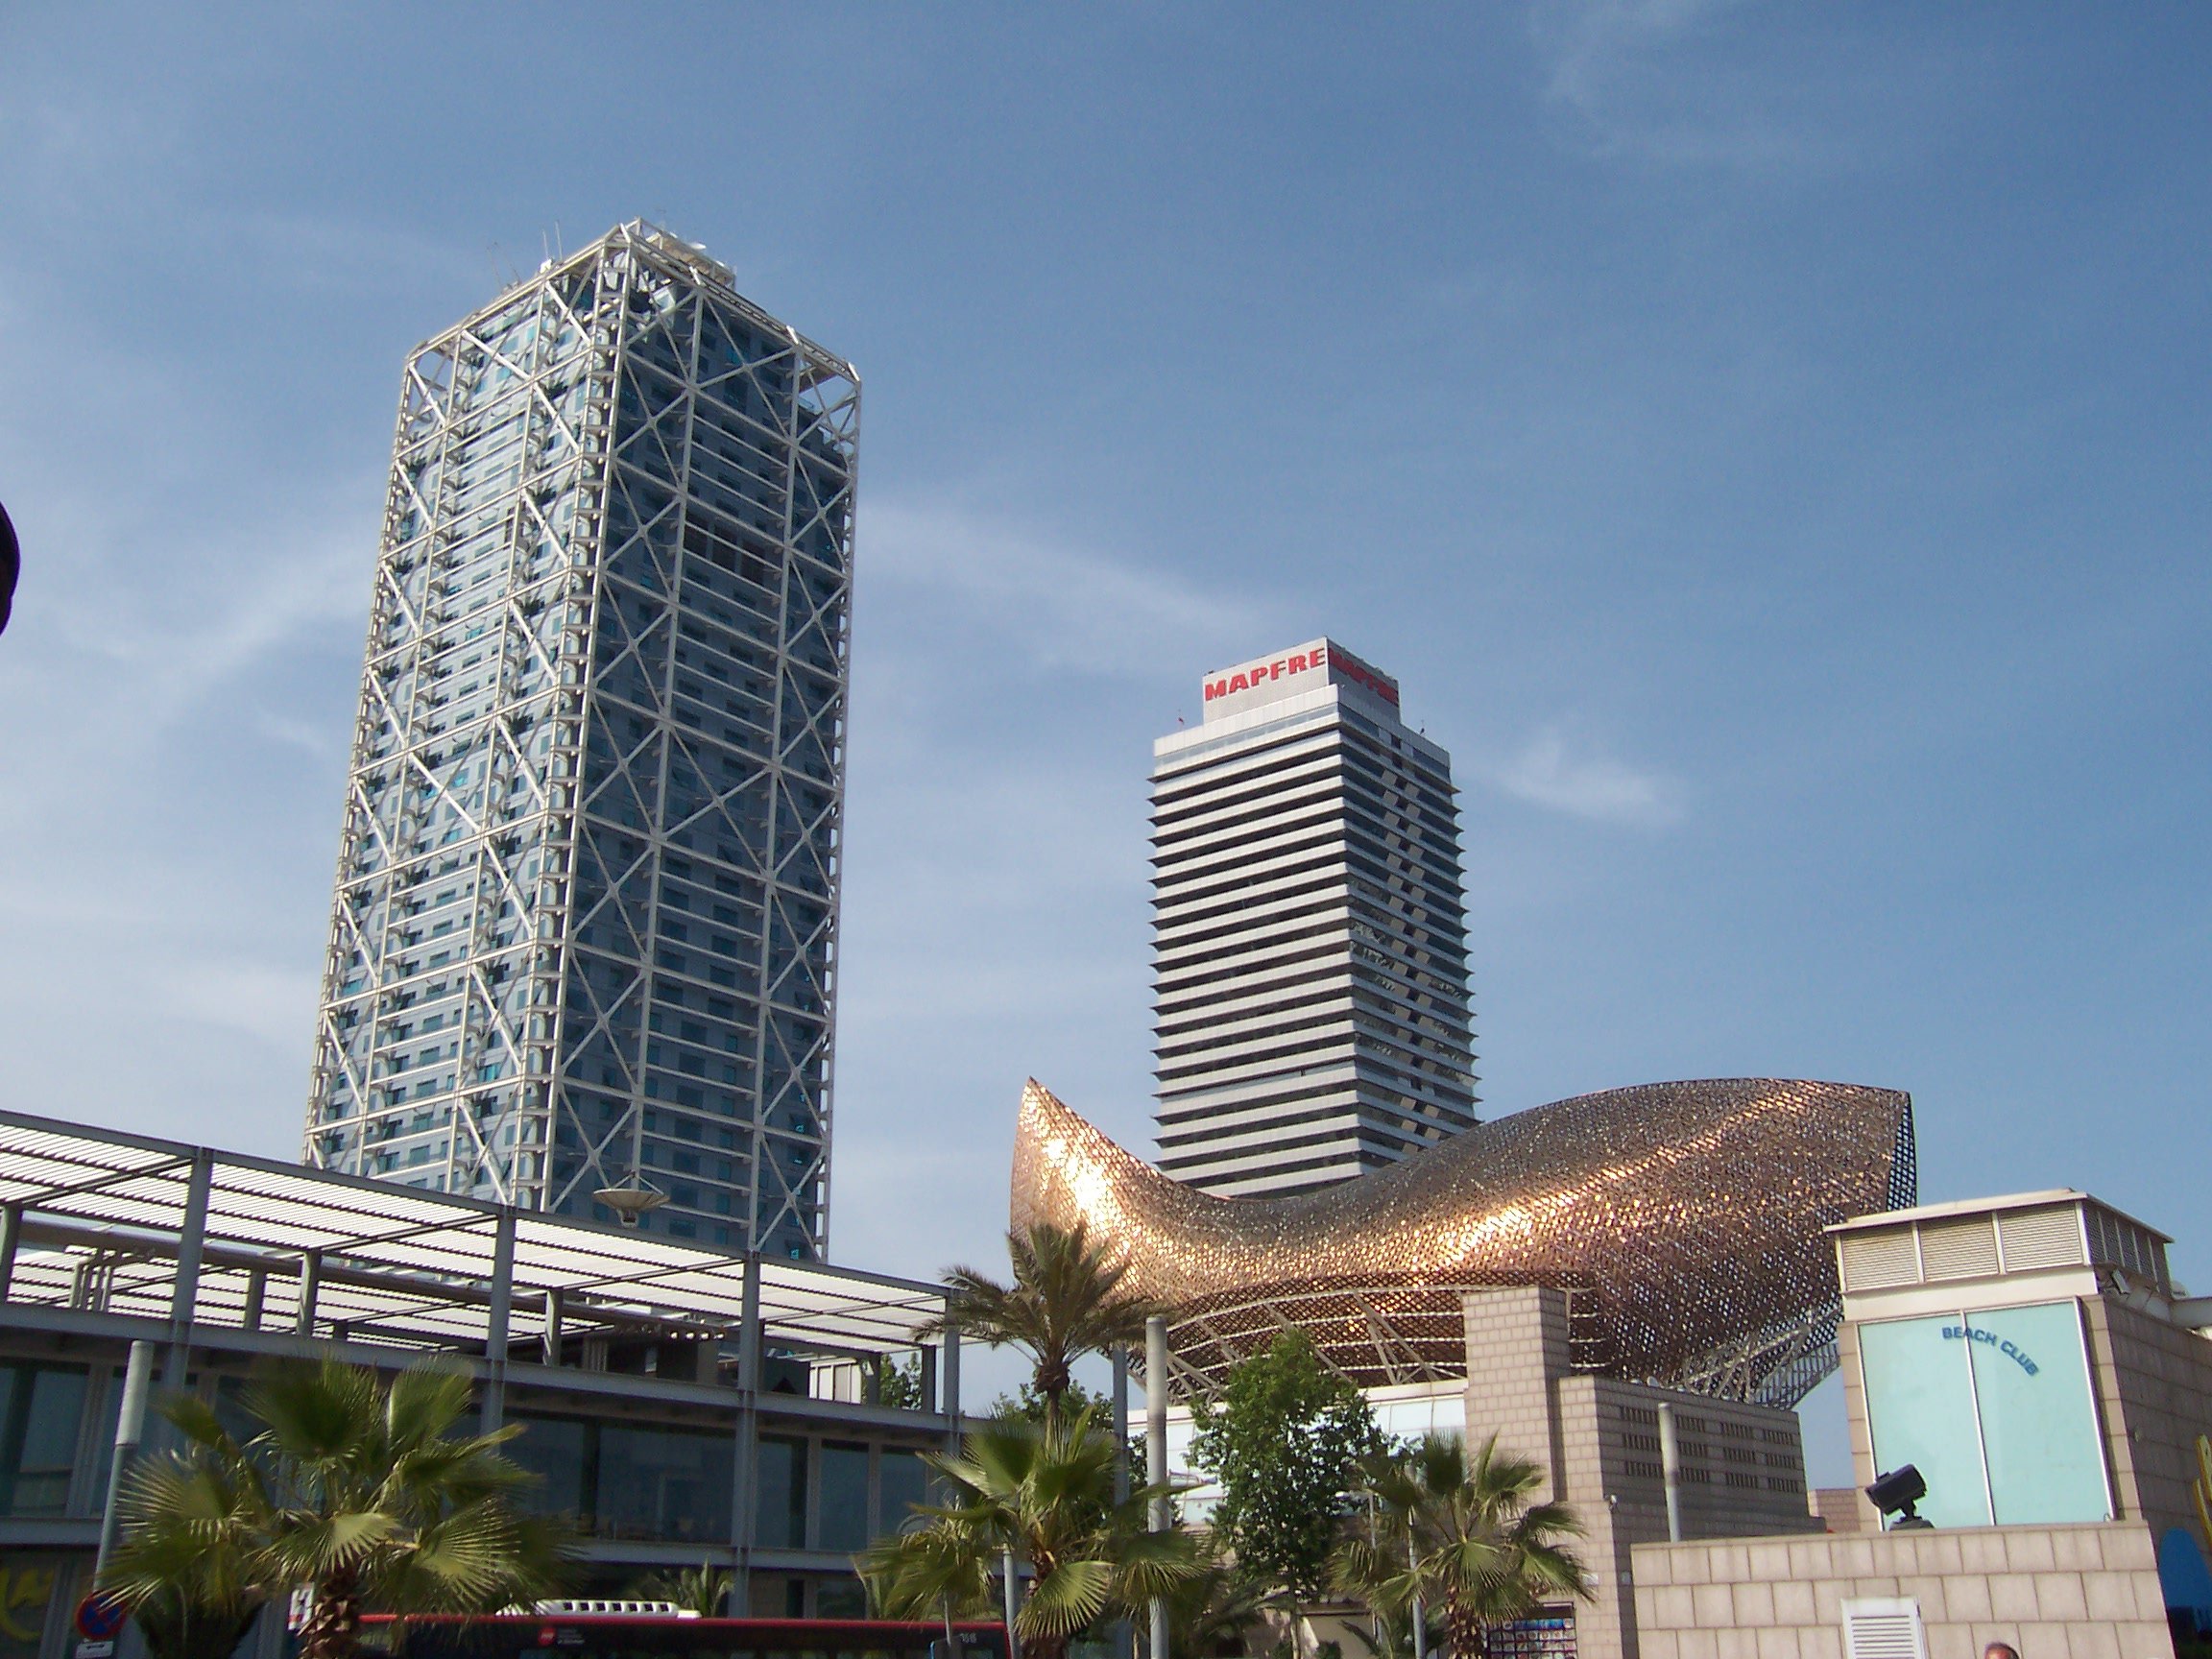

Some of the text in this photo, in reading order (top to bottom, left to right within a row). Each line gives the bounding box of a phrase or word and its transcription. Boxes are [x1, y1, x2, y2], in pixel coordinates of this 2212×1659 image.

[1205, 647, 1326, 701] MAPFRE
[1941, 1326, 2039, 1376] BEACH CLUB
